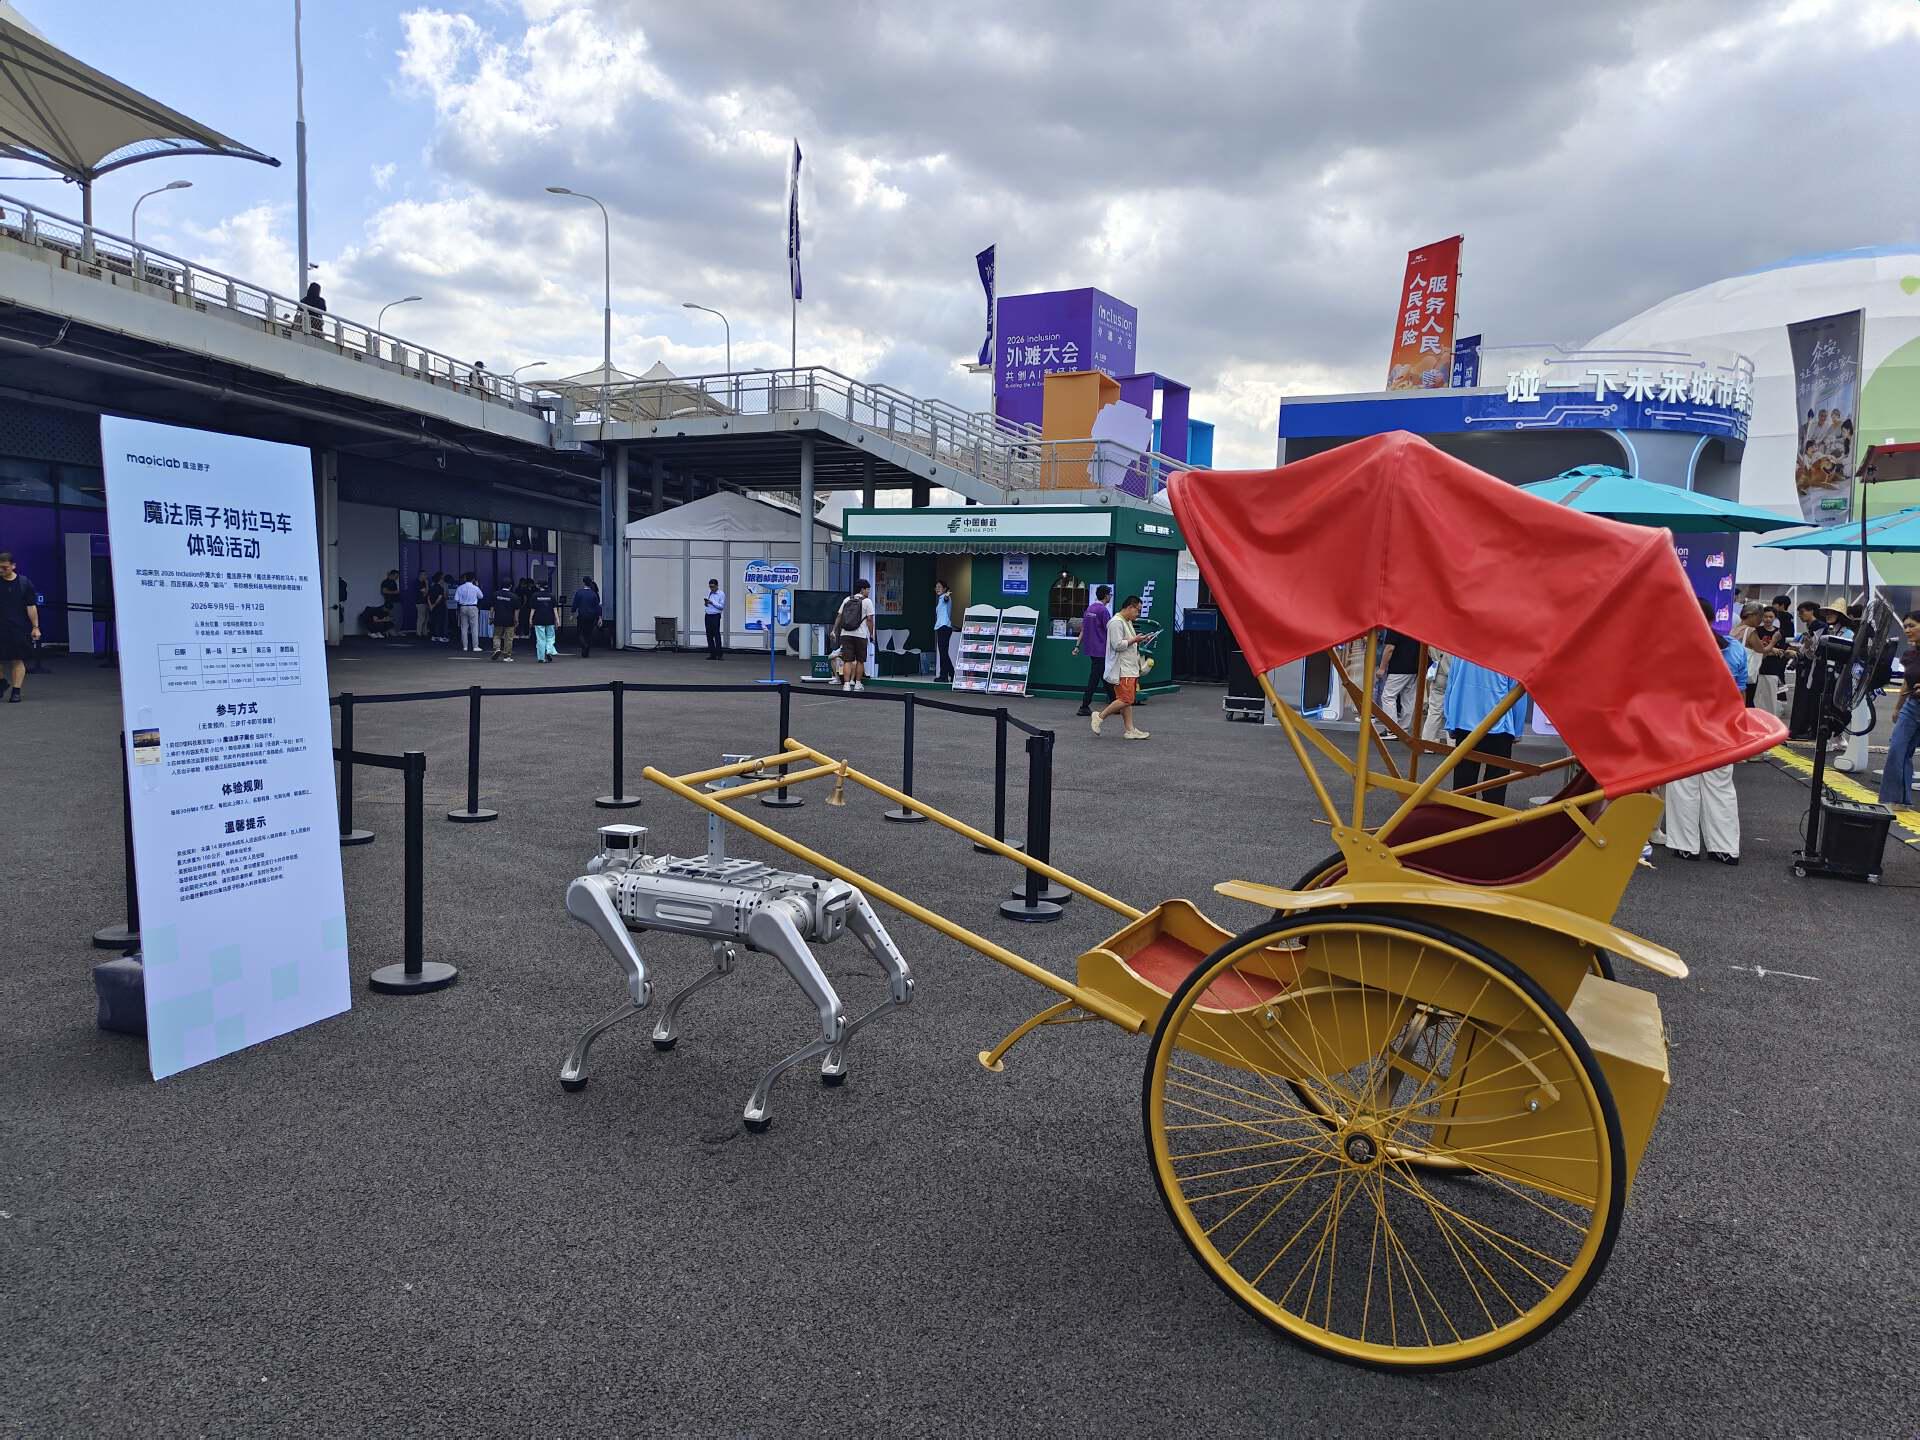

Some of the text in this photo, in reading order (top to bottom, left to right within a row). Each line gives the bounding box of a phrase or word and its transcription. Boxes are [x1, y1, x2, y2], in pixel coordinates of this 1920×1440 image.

[1401, 273, 1427, 347] 人民保险
[1420, 275, 1448, 354] 服务人民
[1007, 335, 1025, 345] 2026
[1006, 342, 1079, 368] 外滩大会
[143, 500, 293, 534] 魔法原子狗拉马车
[963, 518, 997, 527] 中国邮政
[187, 533, 261, 560] 体验活动
[216, 701, 258, 717] 参与方式
[222, 779, 264, 796] 体验规则
[224, 816, 267, 834] 温馨提示
